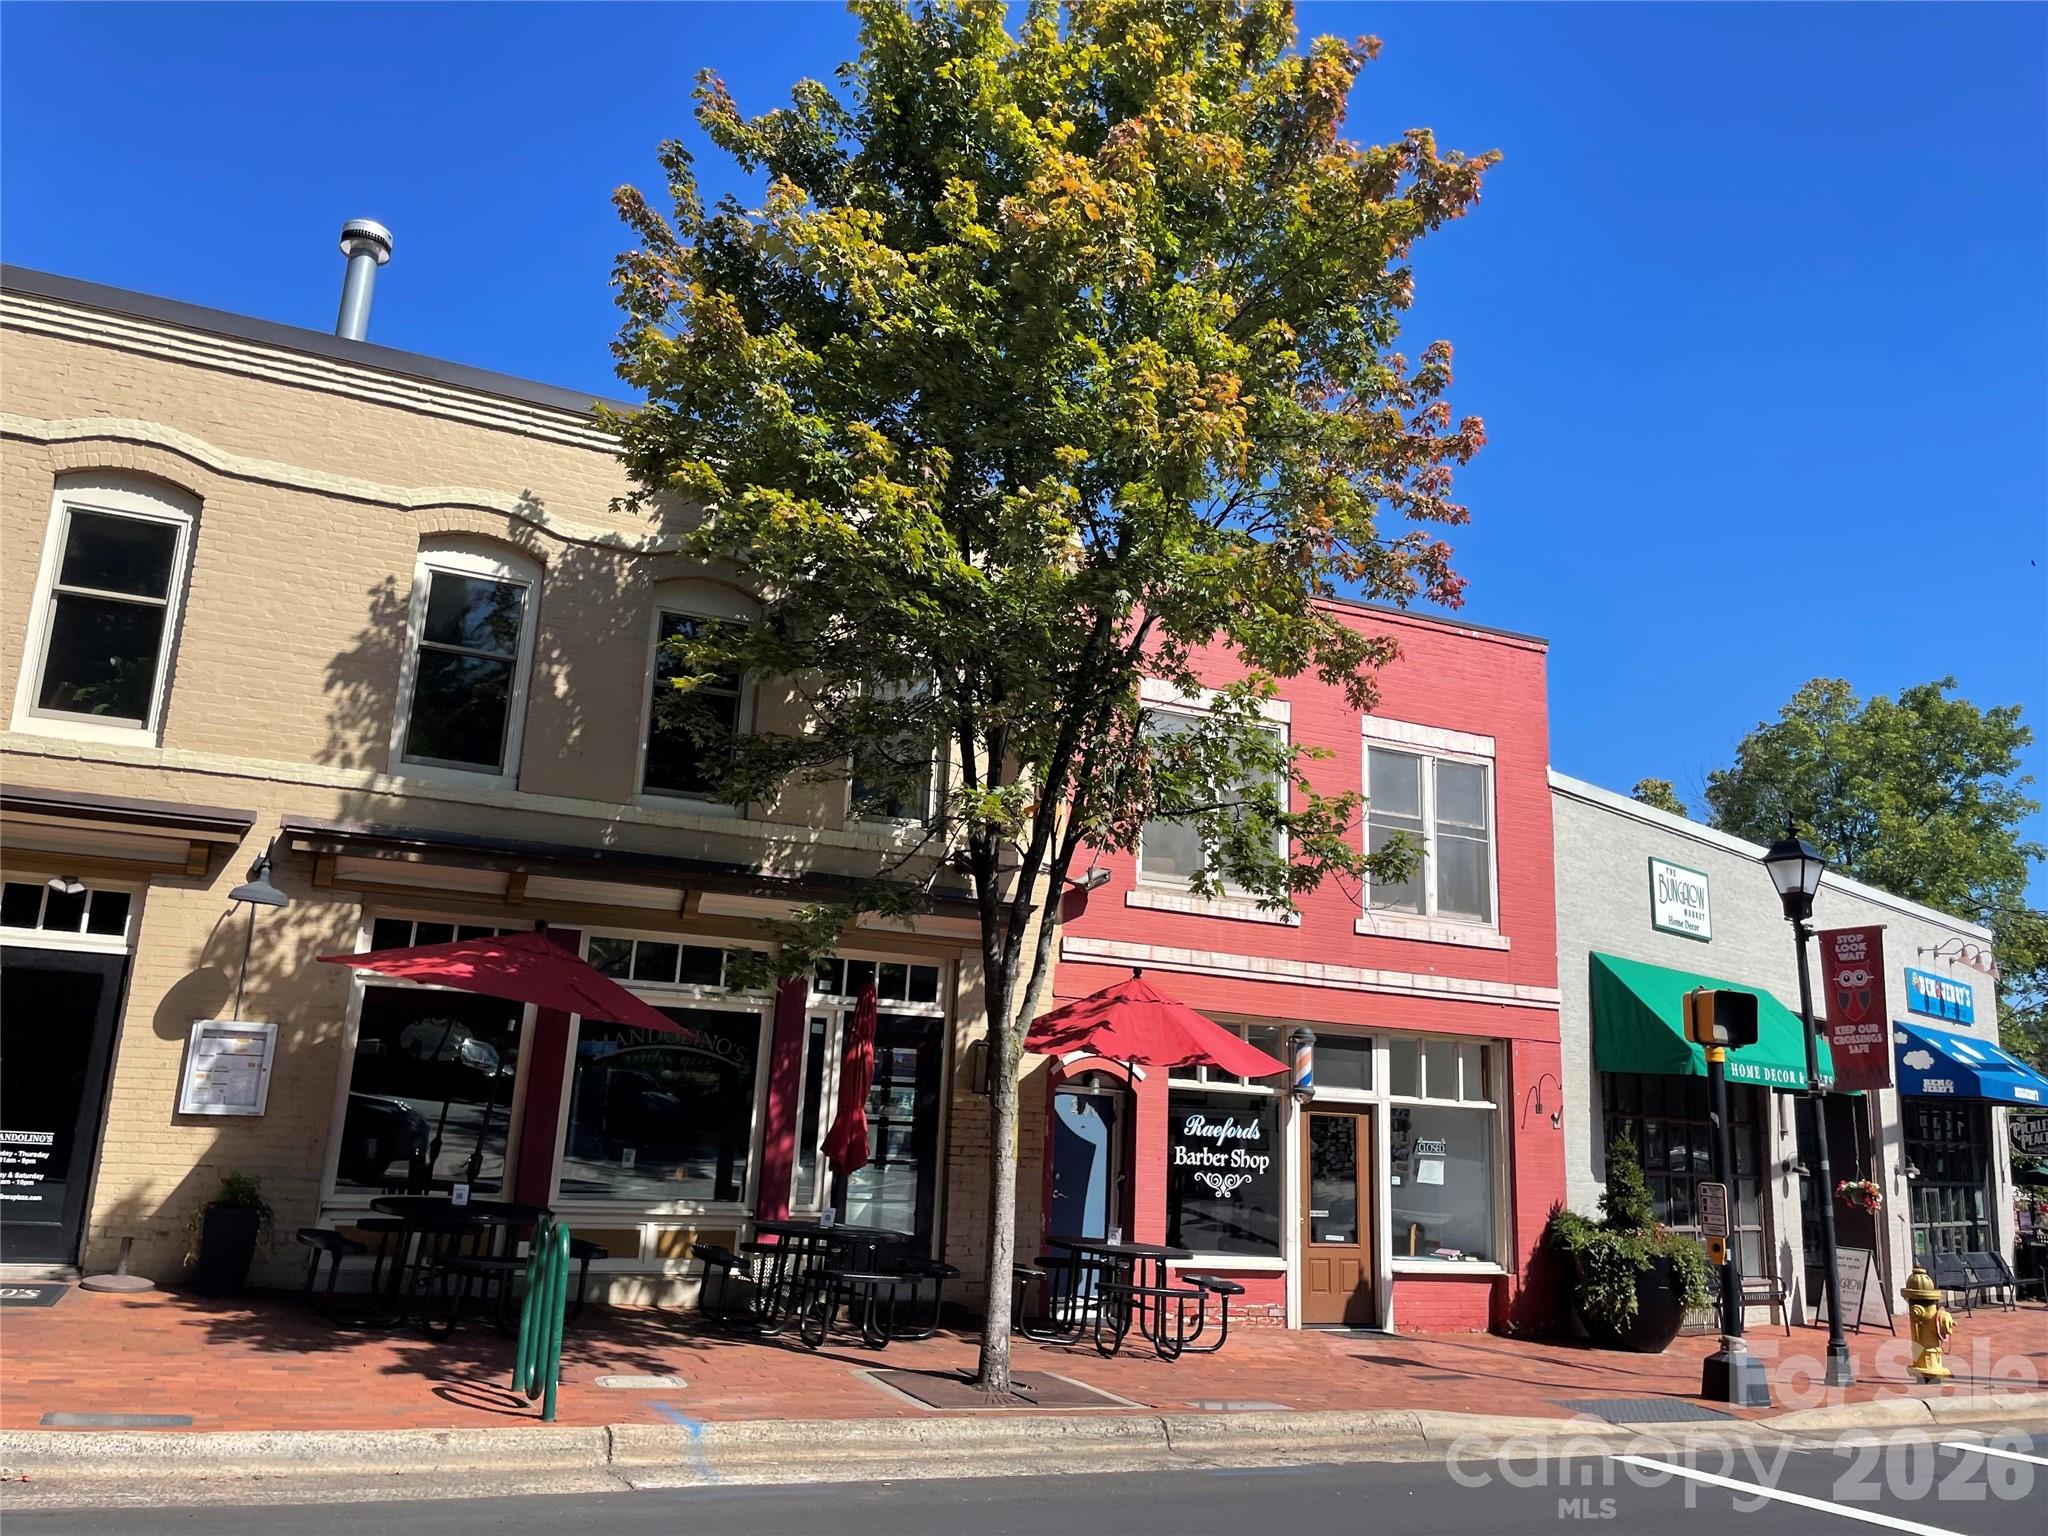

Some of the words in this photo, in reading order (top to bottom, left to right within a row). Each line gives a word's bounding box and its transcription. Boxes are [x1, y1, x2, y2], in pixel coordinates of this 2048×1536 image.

[1659, 873, 1704, 910] BUNGALOW
[1668, 915, 1684, 928] Home
[1685, 920, 1700, 932] Decor
[1836, 934, 1864, 944] STOP
[1835, 943, 1867, 953] LOOK
[1838, 952, 1865, 961] WAIT
[1835, 1025, 1856, 1035] KEEP
[1857, 1024, 1879, 1033] OUR
[1833, 1033, 1883, 1045] CROSSINGS
[1849, 1044, 1870, 1054] SAFE
[1731, 1063, 1760, 1080] HOME
[1764, 1067, 1796, 1084] DECOR
[1798, 1071, 1805, 1085] &
[1184, 1114, 1260, 1146] Raefords
[1418, 1143, 1445, 1153] CLOSED
[18, 1150, 49, 1159] Thursday
[1174, 1146, 1228, 1167] Barber
[1230, 1149, 1270, 1174] Shop
[15, 1172, 44, 1180] Saturday
